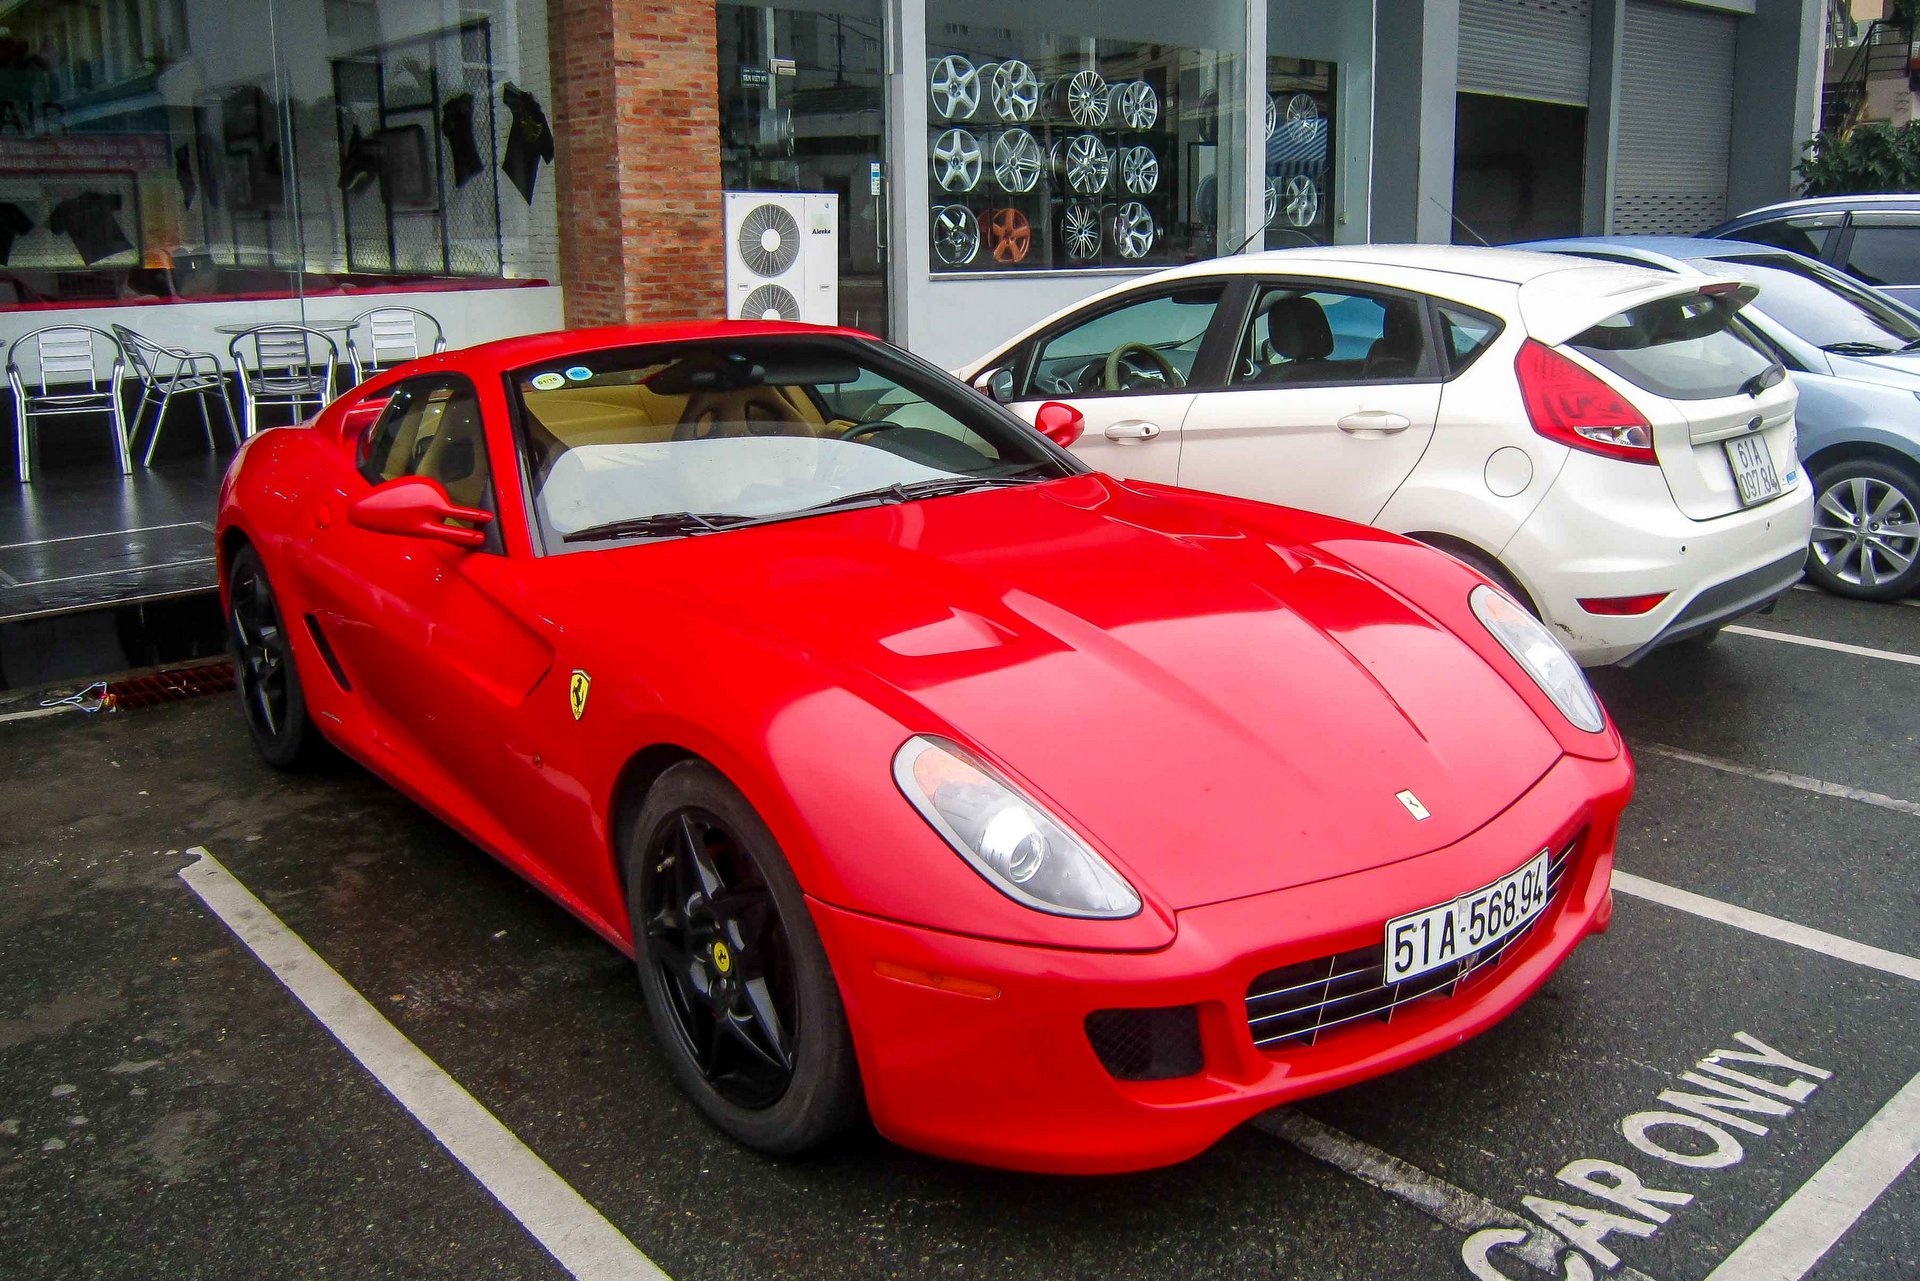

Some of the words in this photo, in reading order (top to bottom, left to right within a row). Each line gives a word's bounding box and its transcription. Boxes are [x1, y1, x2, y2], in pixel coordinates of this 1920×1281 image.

[1737, 438, 1762, 468] 61A
[1394, 861, 1543, 973] 51A-568.94
[1462, 1157, 1695, 1281] CAR
[1621, 1031, 1833, 1169] ONLY
